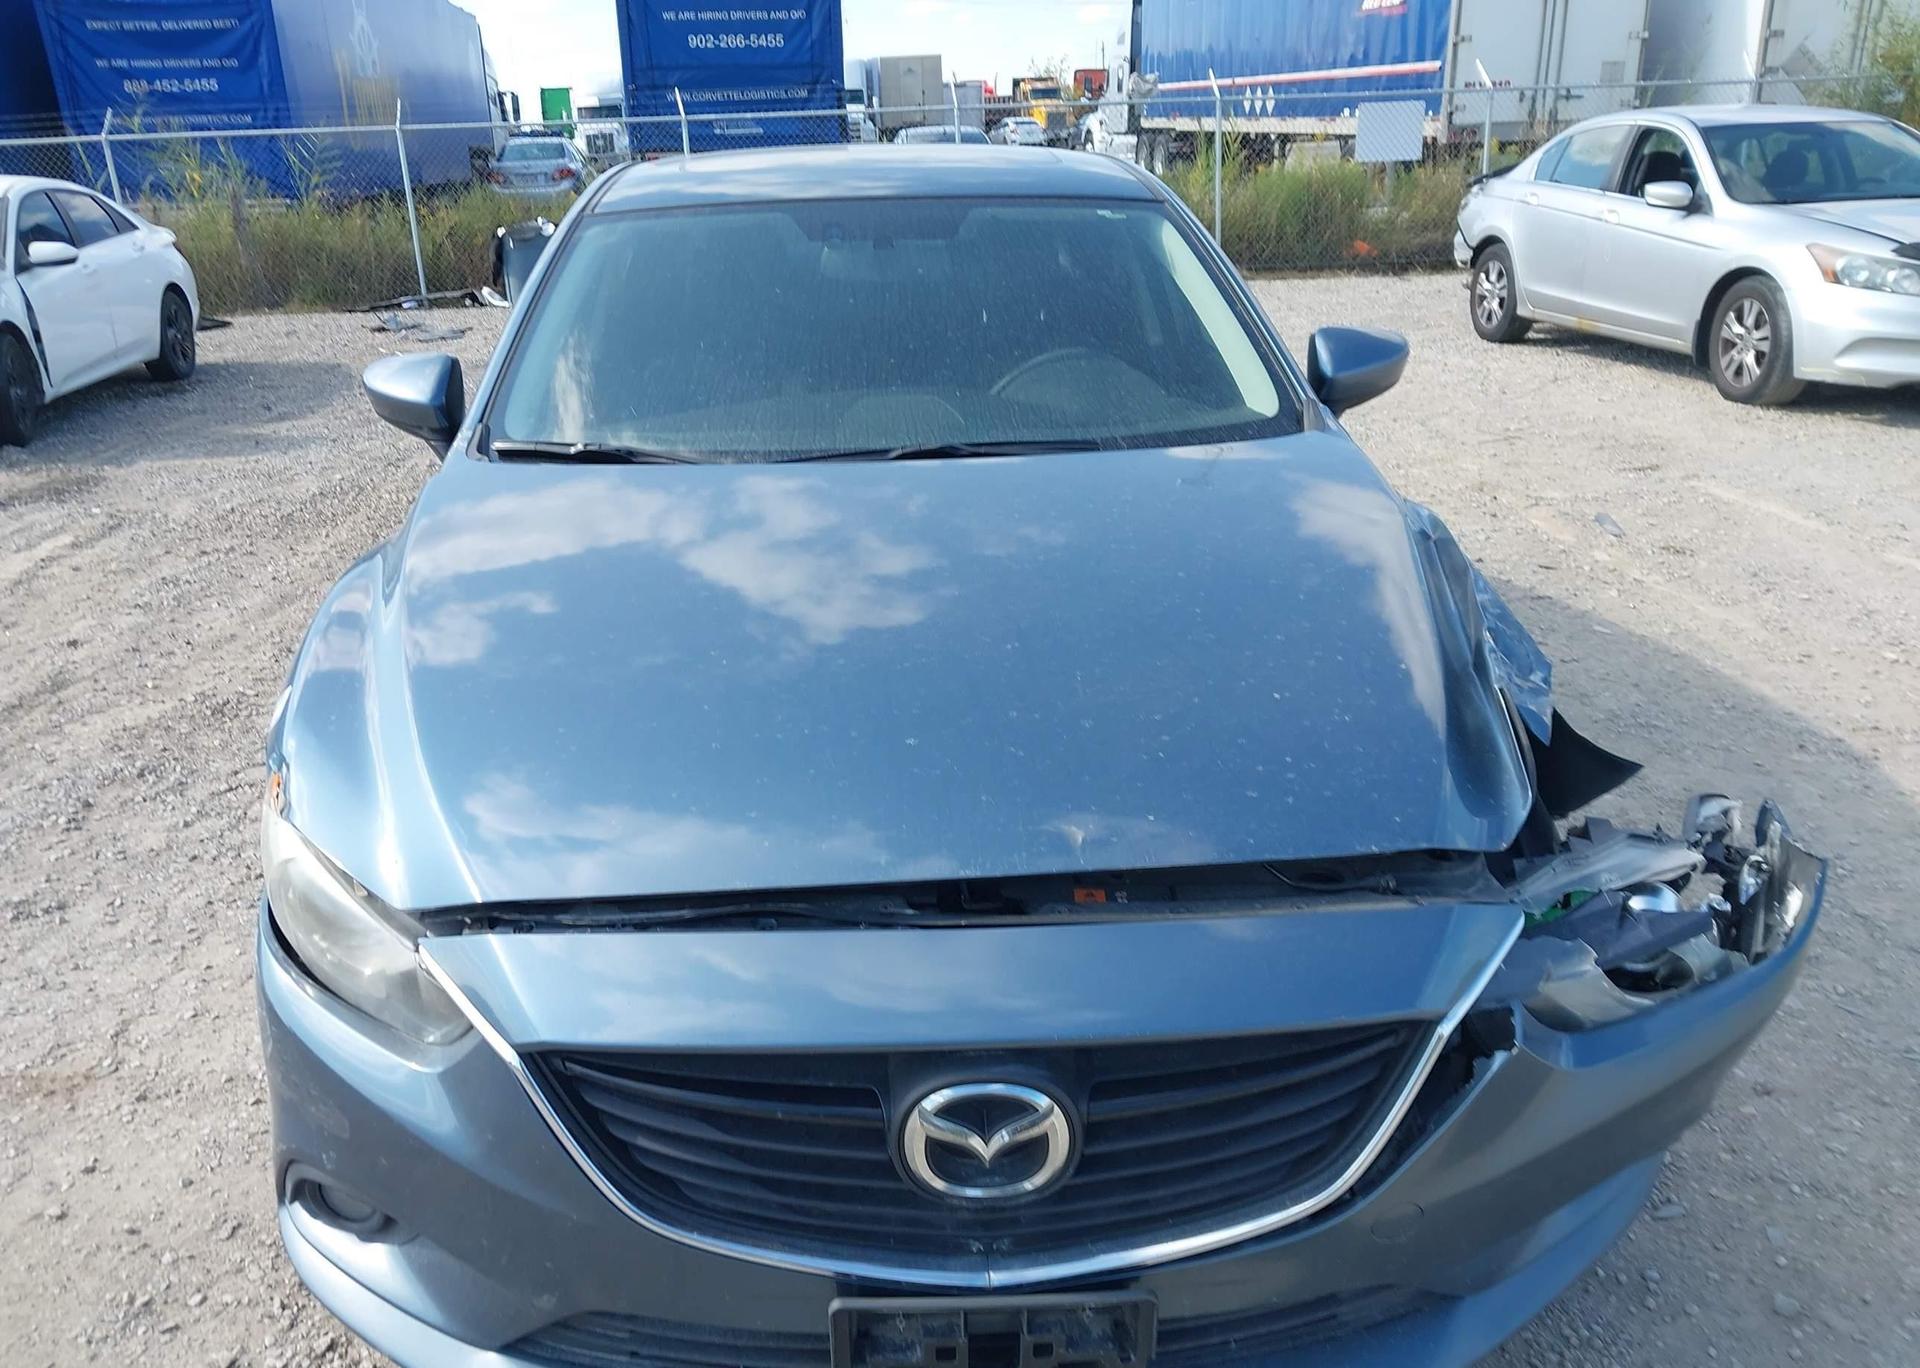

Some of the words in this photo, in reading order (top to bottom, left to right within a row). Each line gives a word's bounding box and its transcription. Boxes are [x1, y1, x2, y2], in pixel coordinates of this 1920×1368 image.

[662, 10, 676, 21] WE
[677, 10, 696, 21] ARE
[698, 10, 728, 21] HIRING
[730, 10, 769, 21] DRIVERS
[770, 10, 789, 20] AND
[85, 19, 121, 31] EXPECT
[161, 19, 212, 31] DELIVERED
[213, 18, 240, 30] BEST!
[687, 33, 785, 49] 902-266-5455
[110, 58, 129, 68] ARE
[130, 58, 162, 68] HIRING
[163, 58, 201, 68] DRIVERS
[202, 58, 221, 68] AND
